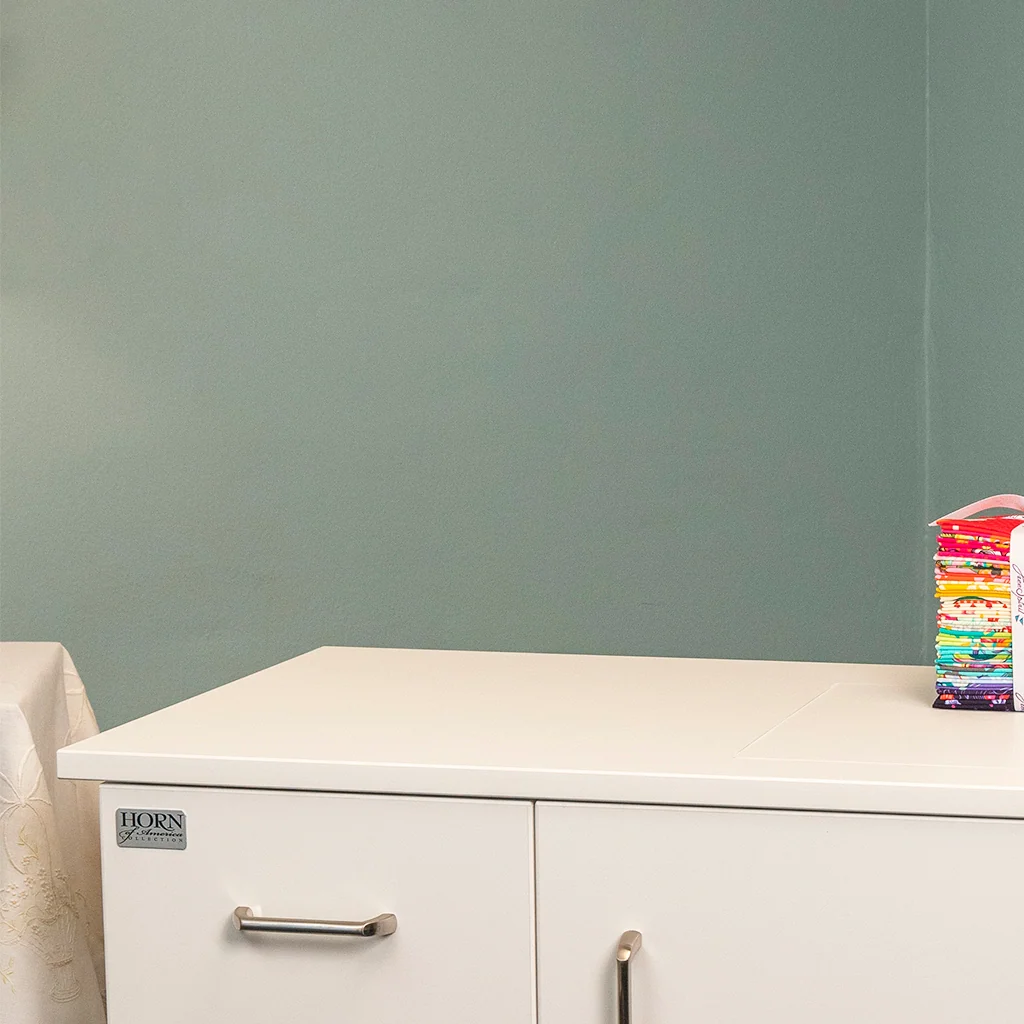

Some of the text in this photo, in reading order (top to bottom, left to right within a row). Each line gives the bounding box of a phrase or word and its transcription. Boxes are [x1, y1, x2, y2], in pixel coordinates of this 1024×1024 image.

[120, 812, 184, 831] HORN
[118, 826, 183, 844] of America
